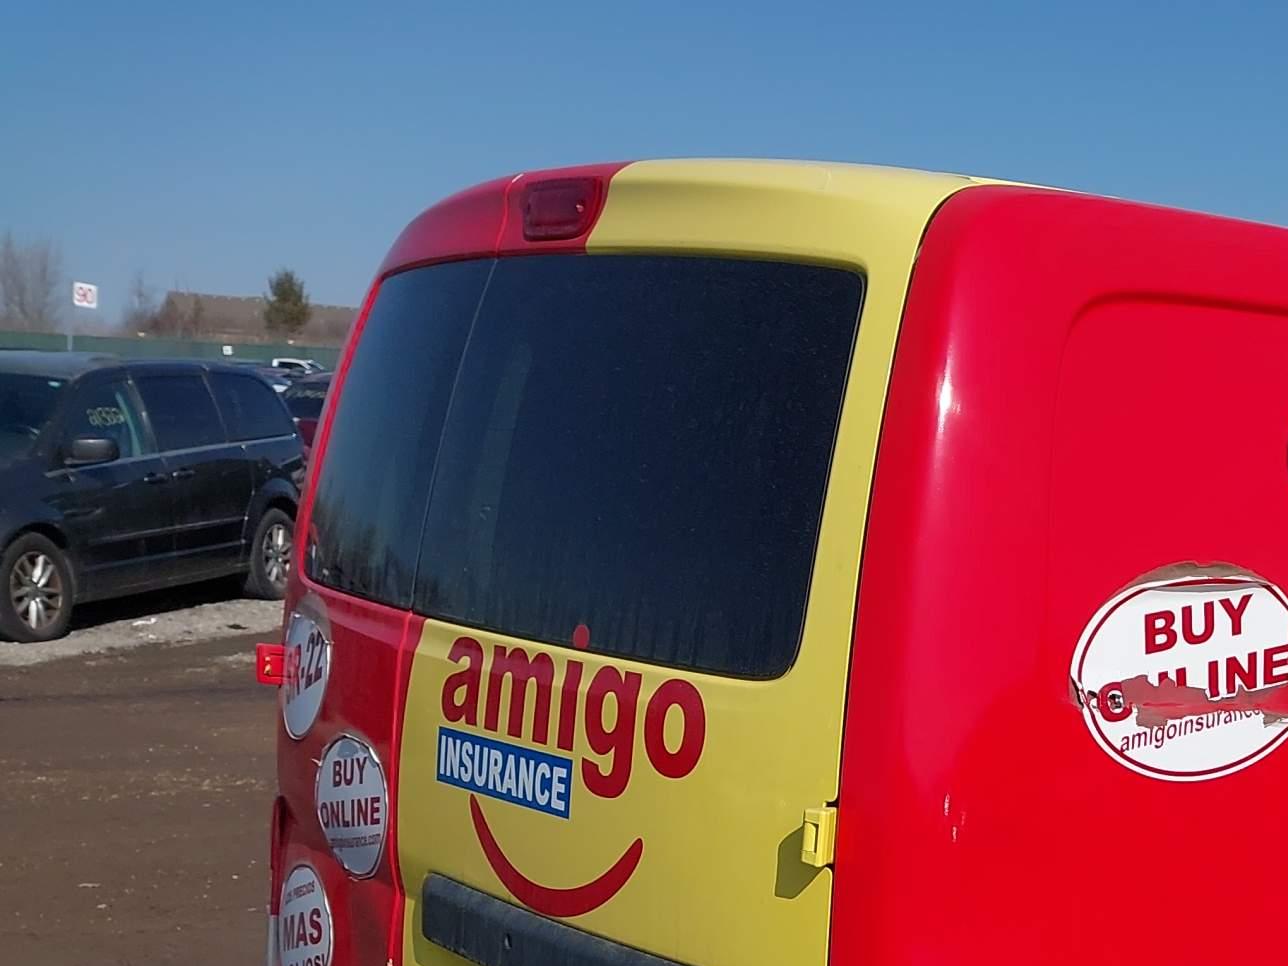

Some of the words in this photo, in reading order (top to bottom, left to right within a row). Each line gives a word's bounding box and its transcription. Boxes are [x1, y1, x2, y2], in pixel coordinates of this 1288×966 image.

[1144, 594, 1254, 655] BUY
[440, 623, 707, 800] amigo
[332, 756, 368, 788] BUY
[438, 734, 568, 813] INSURANCE
[320, 796, 381, 829] ONLINE
[283, 907, 323, 952] MAS
